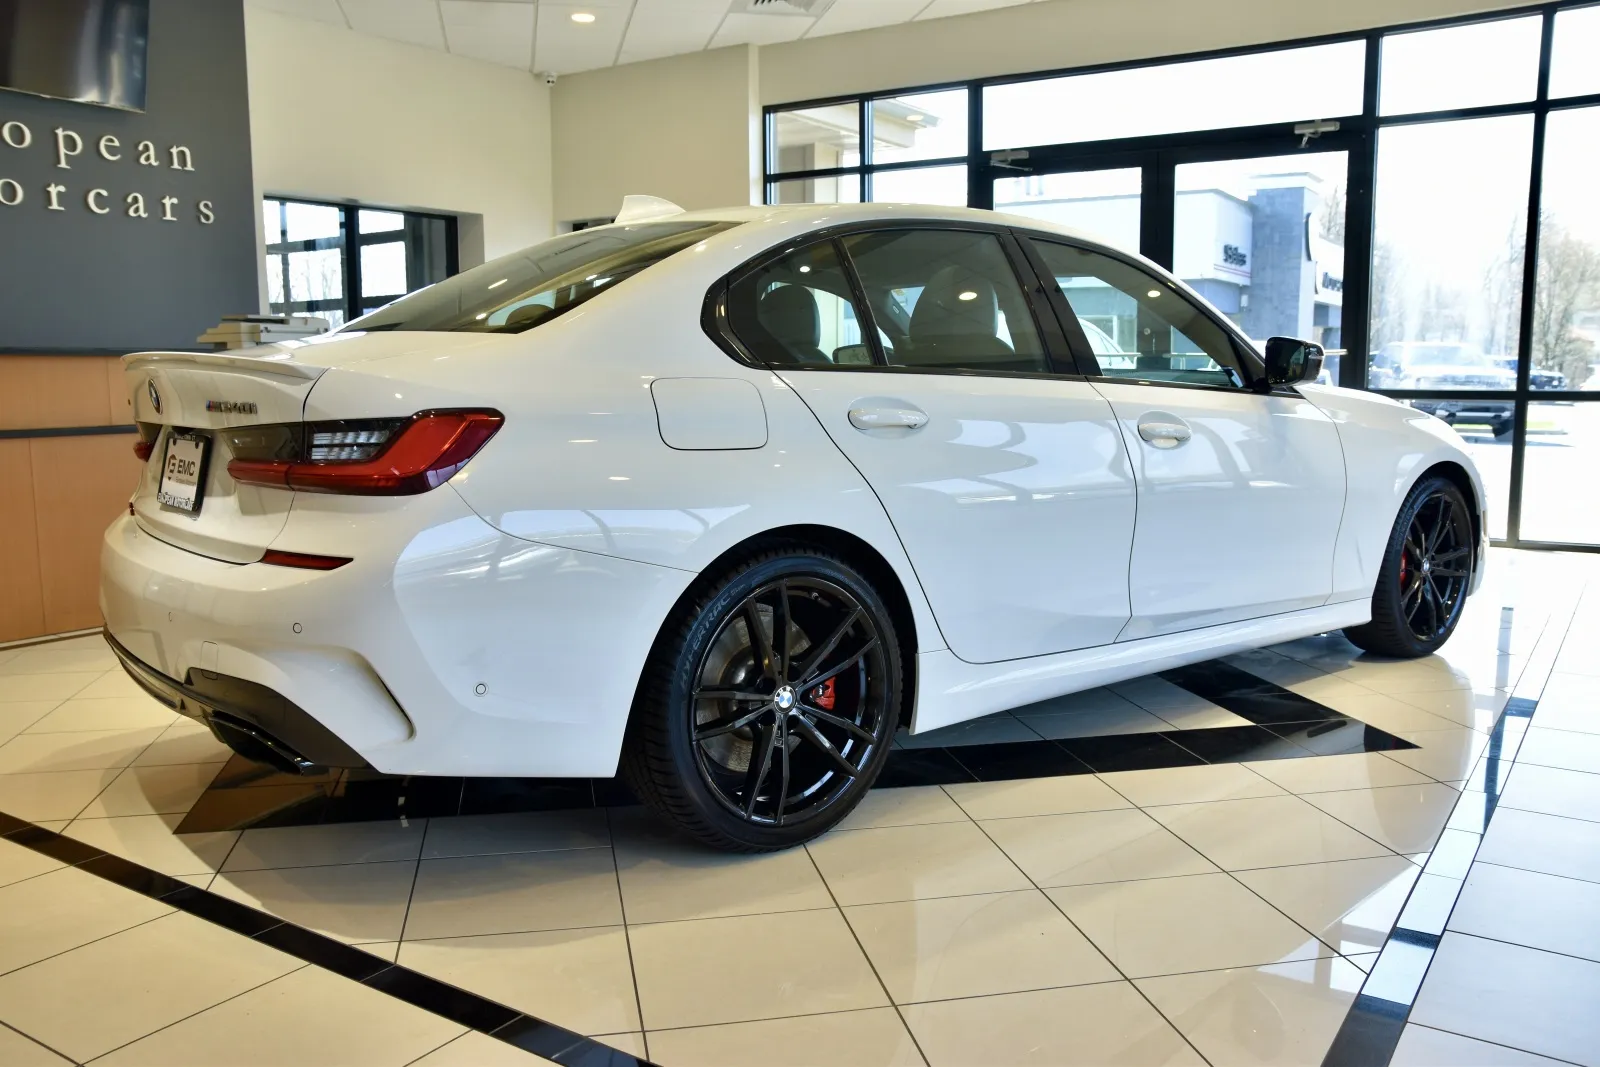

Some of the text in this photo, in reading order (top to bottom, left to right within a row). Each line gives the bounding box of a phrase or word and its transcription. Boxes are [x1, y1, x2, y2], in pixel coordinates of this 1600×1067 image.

[1, 120, 195, 171] opean
[0, 178, 215, 224] orcars
[177, 458, 196, 477] EMC
